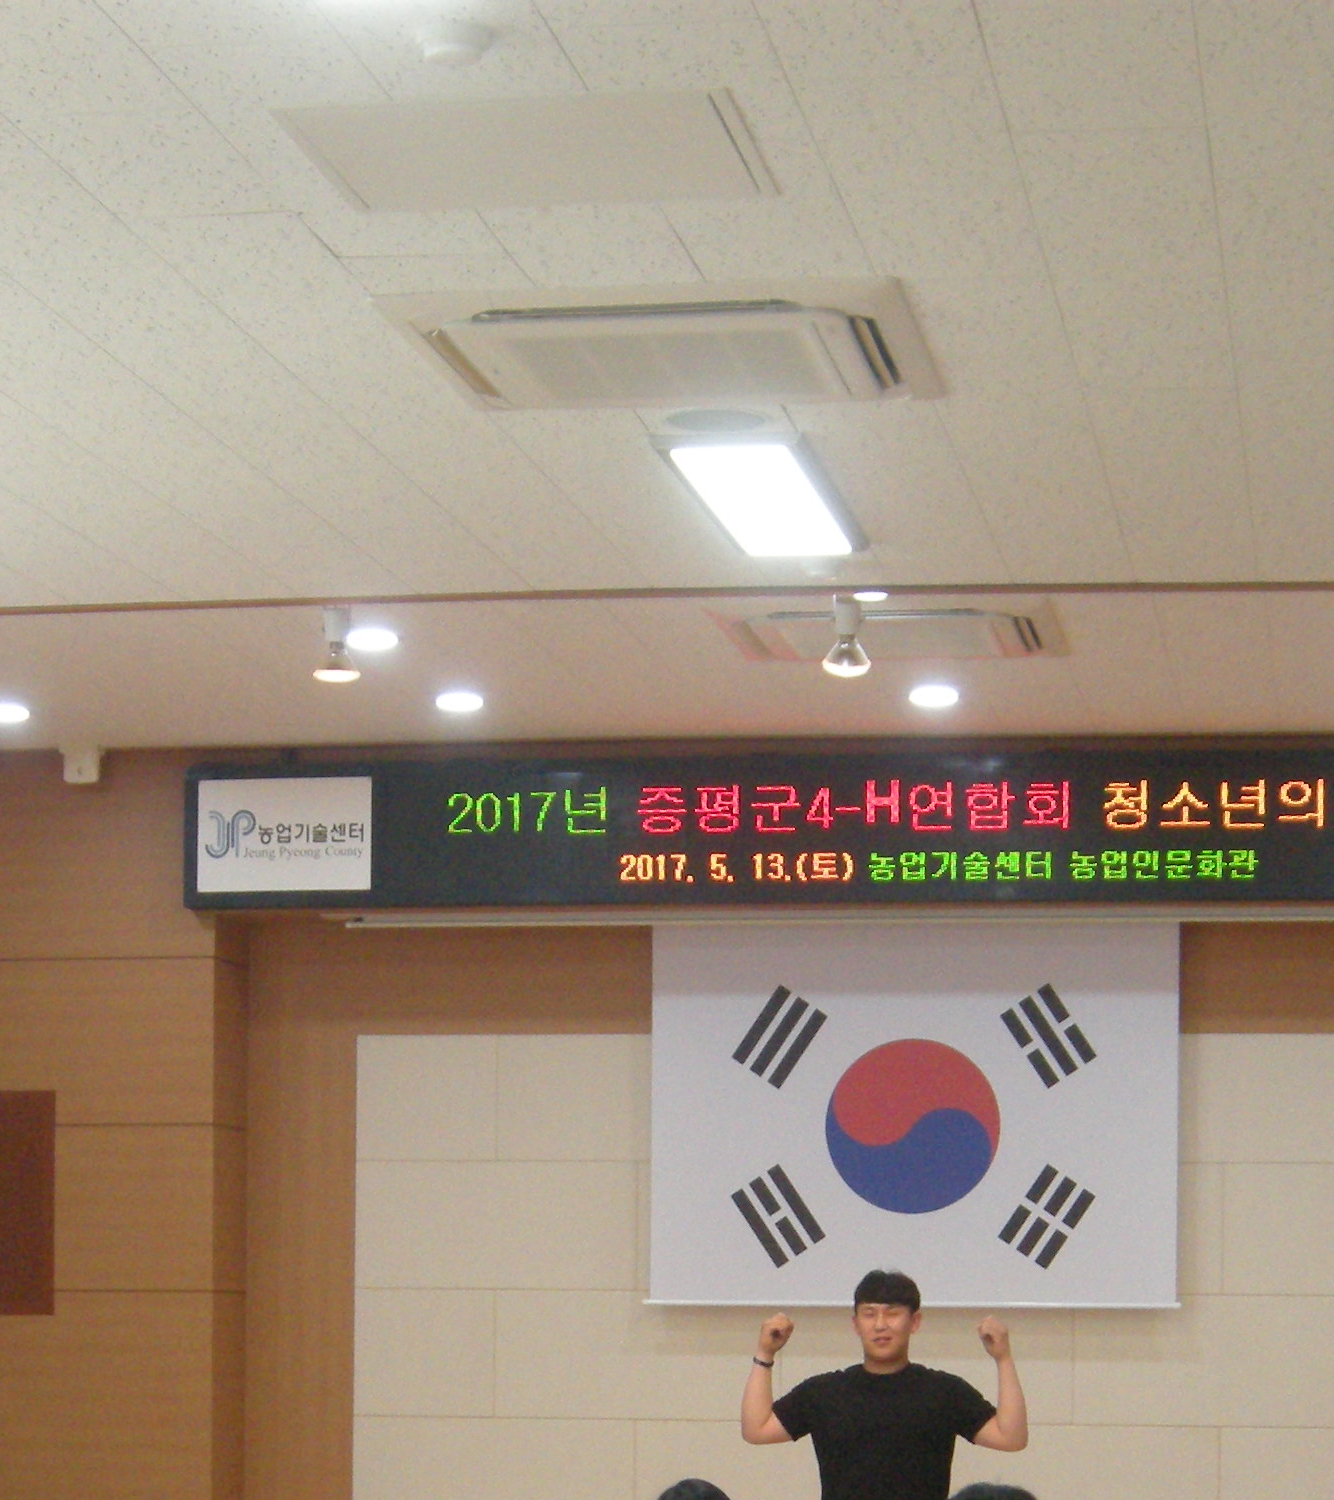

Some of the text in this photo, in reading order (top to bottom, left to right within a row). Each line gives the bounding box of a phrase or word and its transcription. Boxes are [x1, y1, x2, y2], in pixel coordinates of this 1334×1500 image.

[449, 787, 608, 835] 2017년
[636, 780, 1071, 834] 증평군4-H연합회
[1104, 779, 1326, 831] 청소년의
[258, 823, 365, 845] 농업기술센터
[243, 844, 364, 861] Jeung Pyeong County
[620, 849, 1260, 884] 2017. 5. 13.(토) 농업기술센터 농업인문화관
